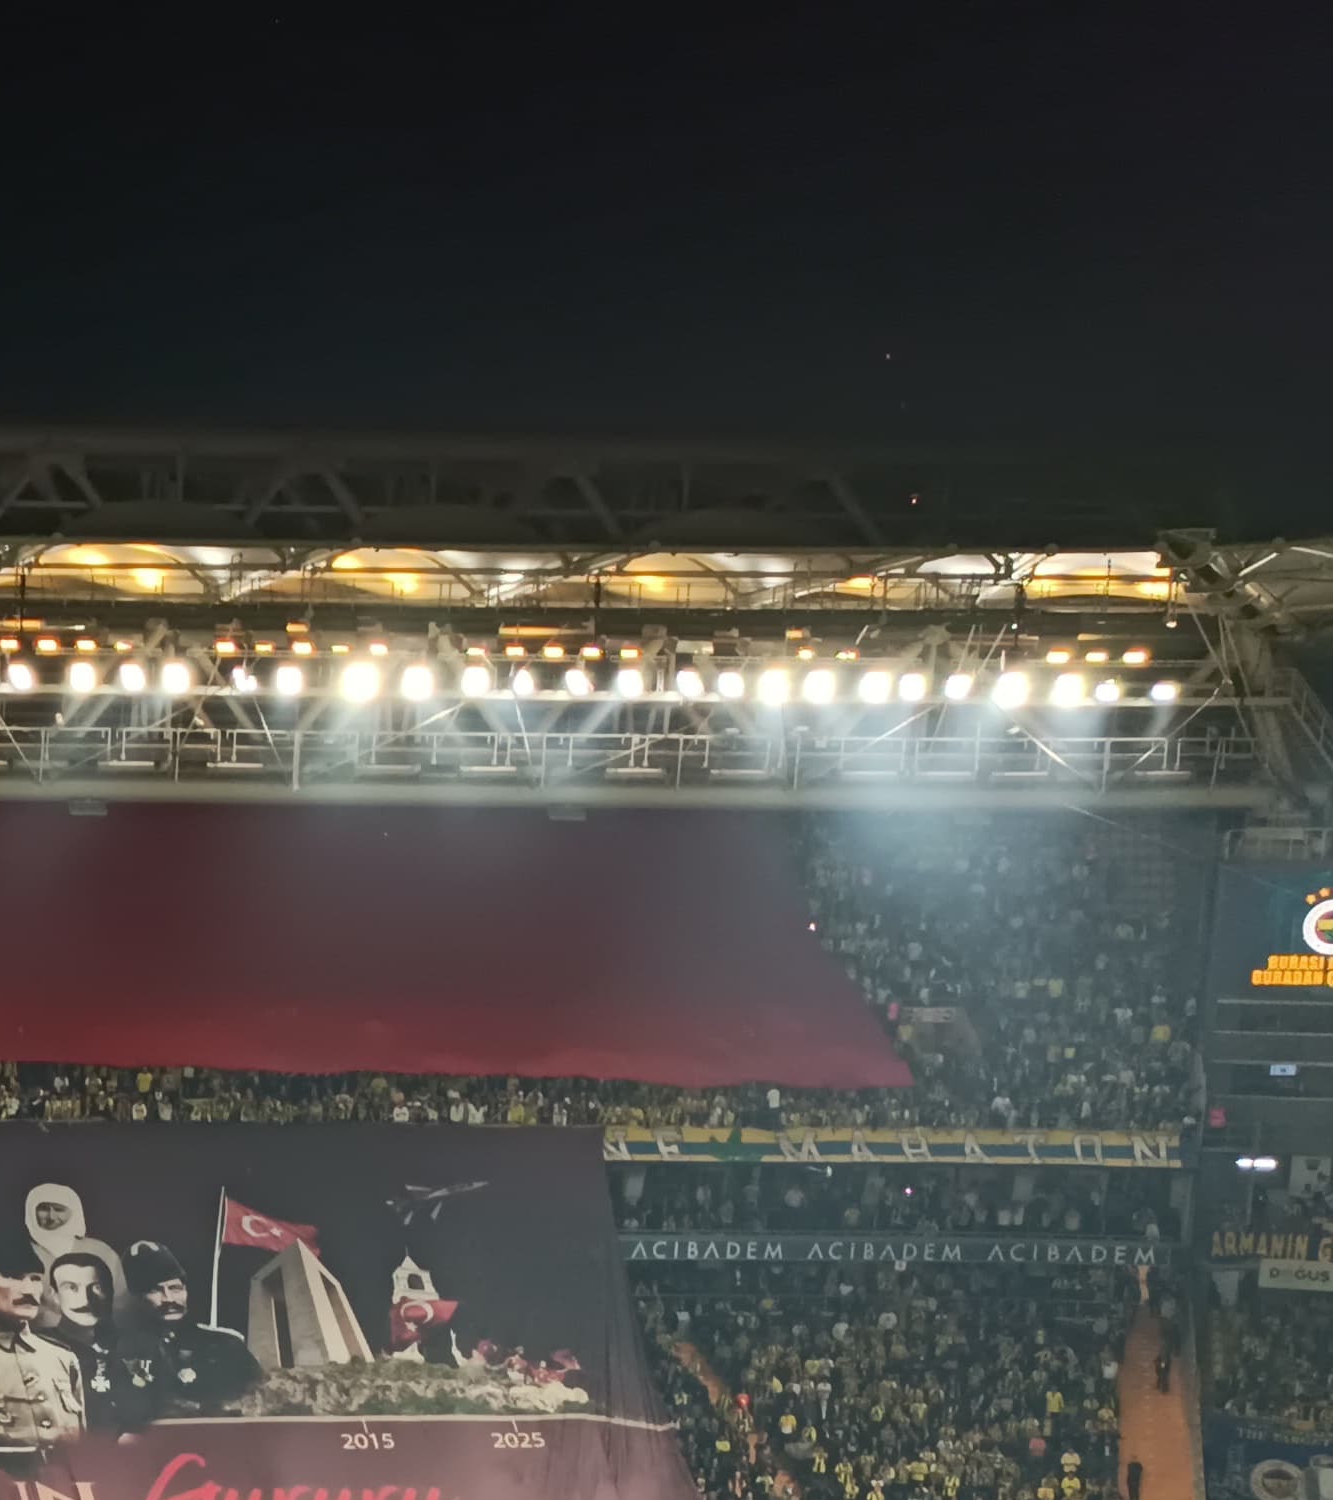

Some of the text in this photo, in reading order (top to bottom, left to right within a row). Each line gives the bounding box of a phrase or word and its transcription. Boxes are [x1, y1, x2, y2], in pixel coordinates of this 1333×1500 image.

[630, 1241, 784, 1260] ACIBADEM
[807, 1242, 962, 1262] ACIBADEM
[988, 1243, 1156, 1264] ACIBADEM
[342, 1431, 395, 1451] 2015
[491, 1431, 546, 1450] 2025
